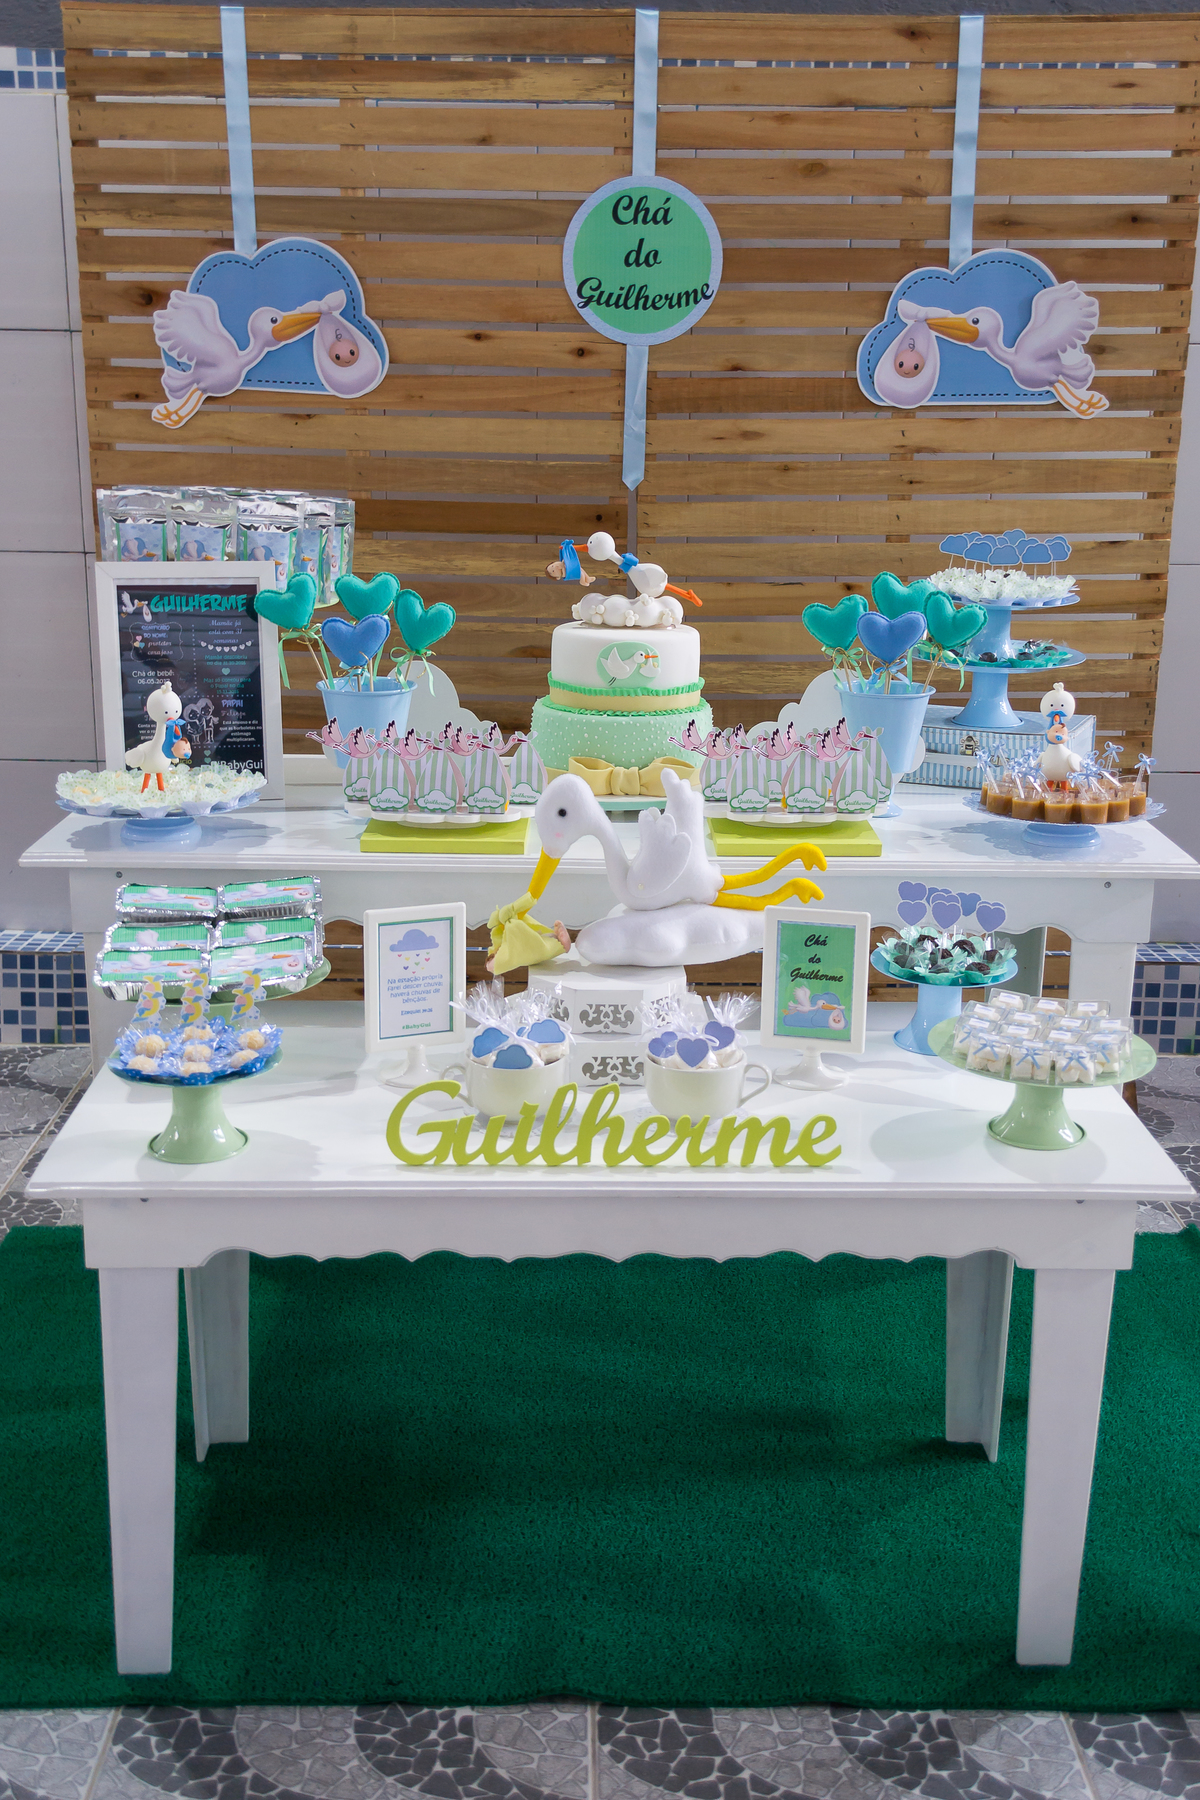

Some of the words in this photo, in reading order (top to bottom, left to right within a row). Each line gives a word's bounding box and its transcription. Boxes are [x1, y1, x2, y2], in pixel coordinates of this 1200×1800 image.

[612, 195, 673, 225] Chá
[624, 238, 662, 268] do
[576, 276, 714, 310] Guilherme
[150, 594, 247, 612] GUILHERME
[221, 699, 243, 708] PAPAI
[217, 760, 263, 771] BabyGui
[424, 798, 450, 806] Guilherme
[804, 934, 829, 947] Chá
[808, 954, 821, 964] do
[422, 973, 443, 981] própria
[790, 968, 844, 982] Guilherme
[386, 1080, 842, 1167] Guilherme
